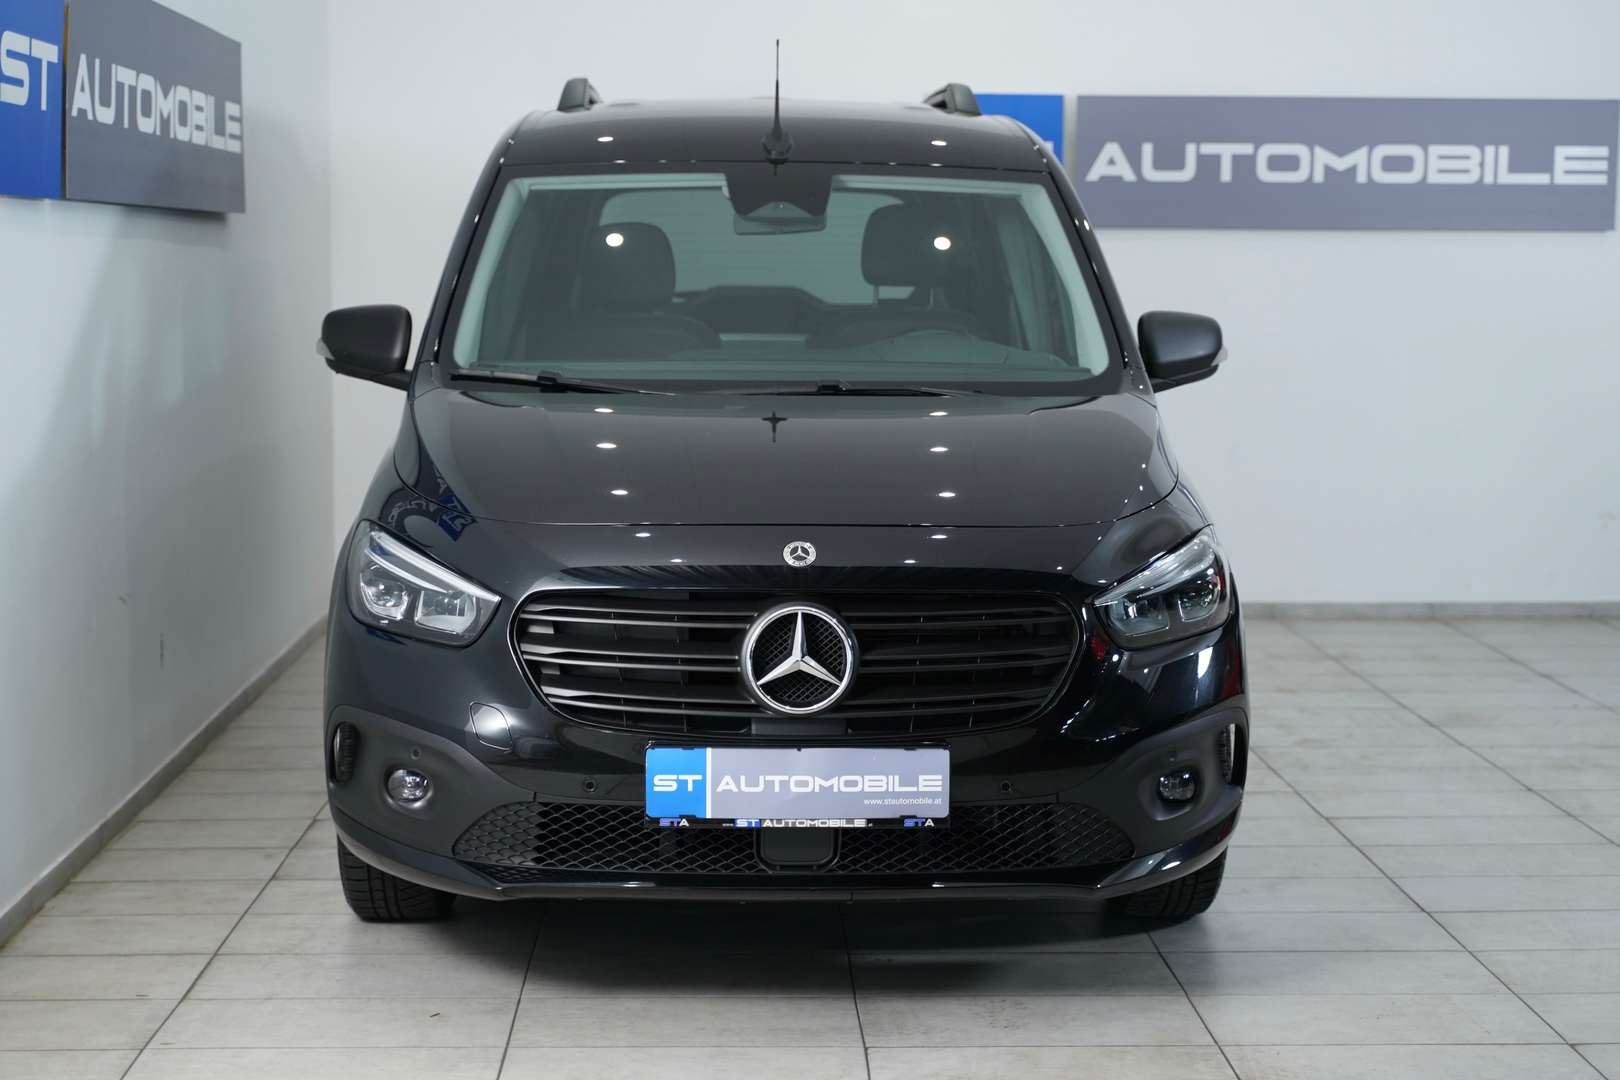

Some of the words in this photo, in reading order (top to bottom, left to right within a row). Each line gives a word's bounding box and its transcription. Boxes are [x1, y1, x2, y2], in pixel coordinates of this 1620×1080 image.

[0, 30, 59, 112] ST
[71, 53, 242, 154] AUTOMOBILE
[1085, 141, 1609, 186] AUTOMOBILE
[652, 775, 702, 792] ST
[716, 775, 943, 793] AUTOMOBILE
[863, 797, 942, 806] www.stautomobile.at
[736, 819, 760, 827] ST
[762, 819, 867, 828] AUTOMOBILE
